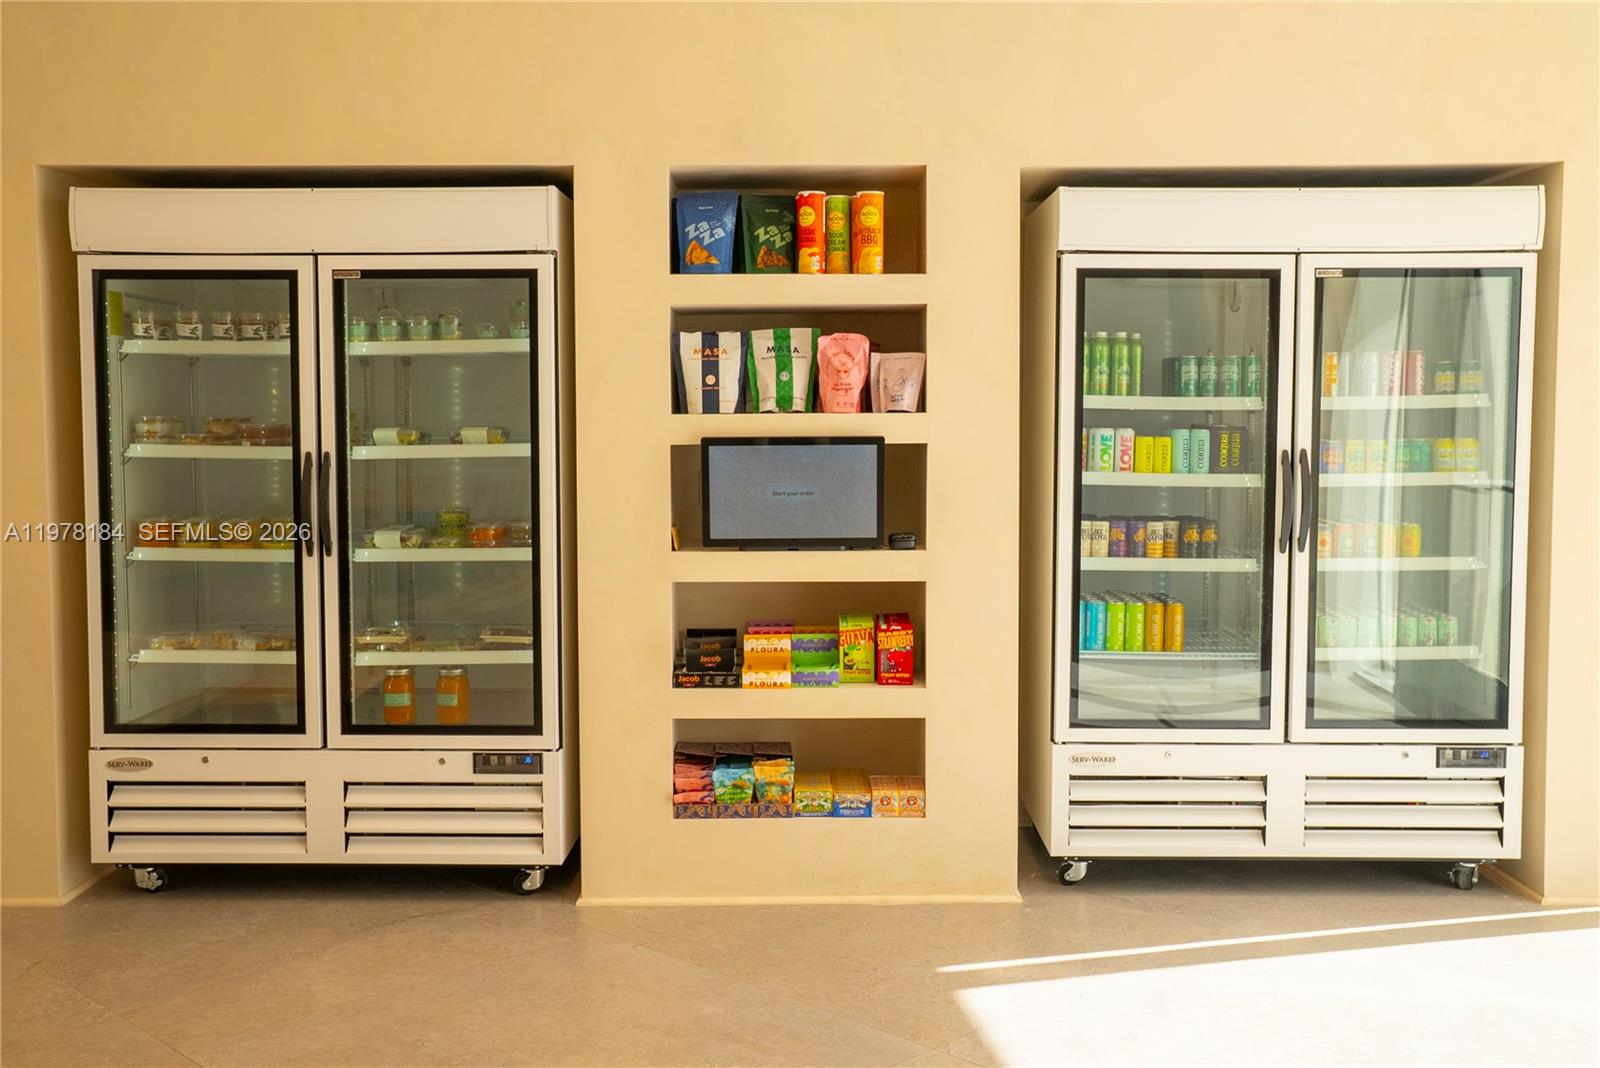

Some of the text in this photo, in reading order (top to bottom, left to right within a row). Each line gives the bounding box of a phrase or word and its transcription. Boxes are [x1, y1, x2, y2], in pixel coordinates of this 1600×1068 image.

[860, 234, 879, 245] BBQ
[693, 346, 729, 356] MASA
[766, 345, 800, 355] MASA
[1099, 434, 1113, 471] LOVE
[1119, 435, 1132, 472] LOVE
